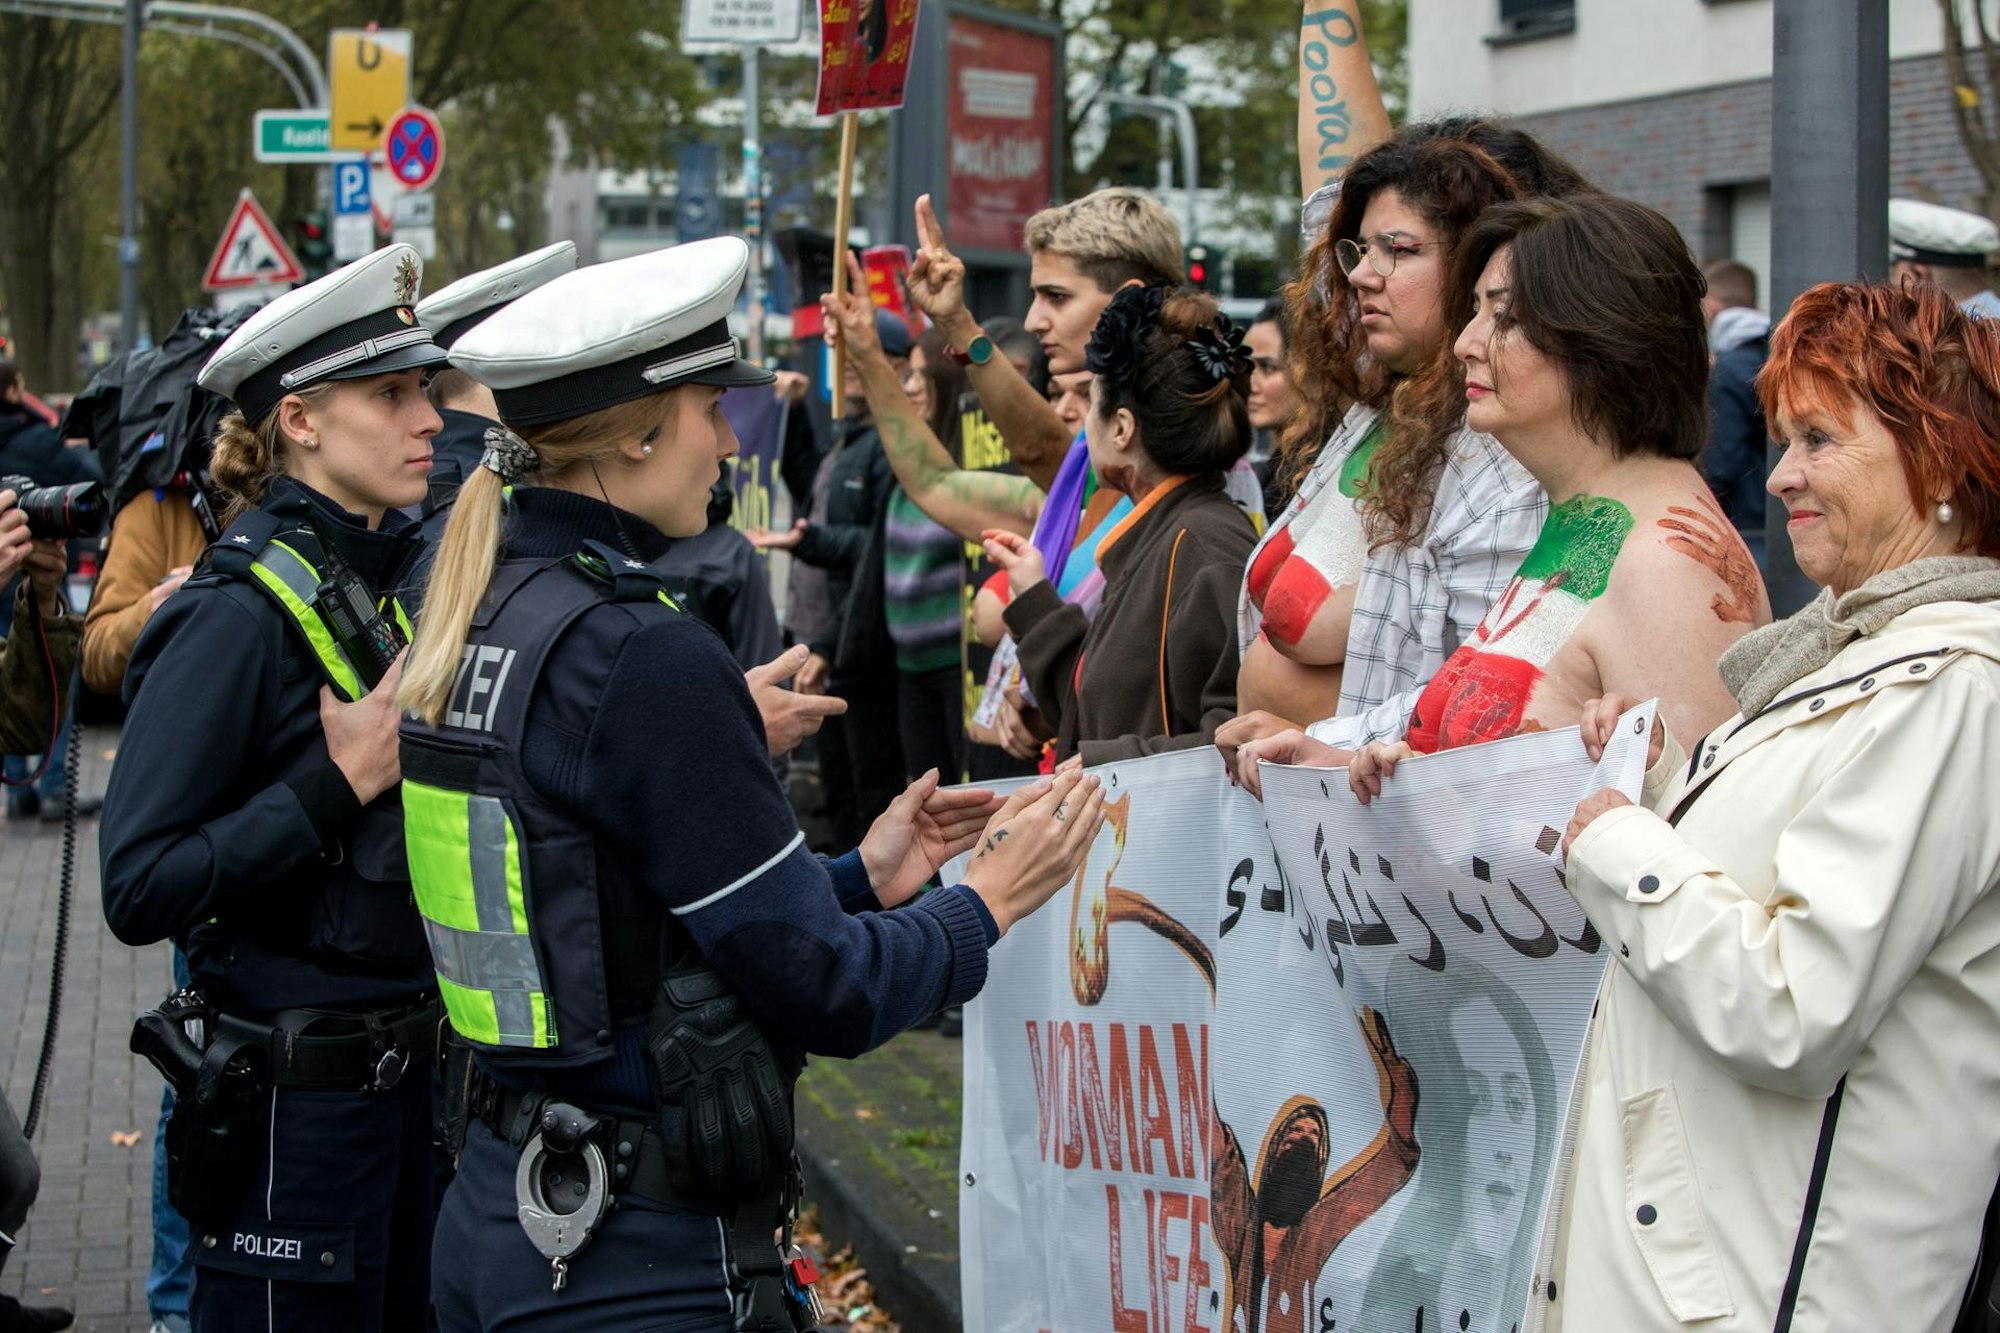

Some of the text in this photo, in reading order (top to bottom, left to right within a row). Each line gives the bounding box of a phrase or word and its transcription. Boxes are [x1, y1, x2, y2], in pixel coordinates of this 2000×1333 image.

[356, 39, 382, 71] U
[341, 164, 365, 210] P
[445, 643, 518, 732] ZEI
[1025, 1019, 1209, 1182] WOMAN
[233, 1232, 302, 1260] POLIZEI
[1105, 1183, 1211, 1333] LIFE
